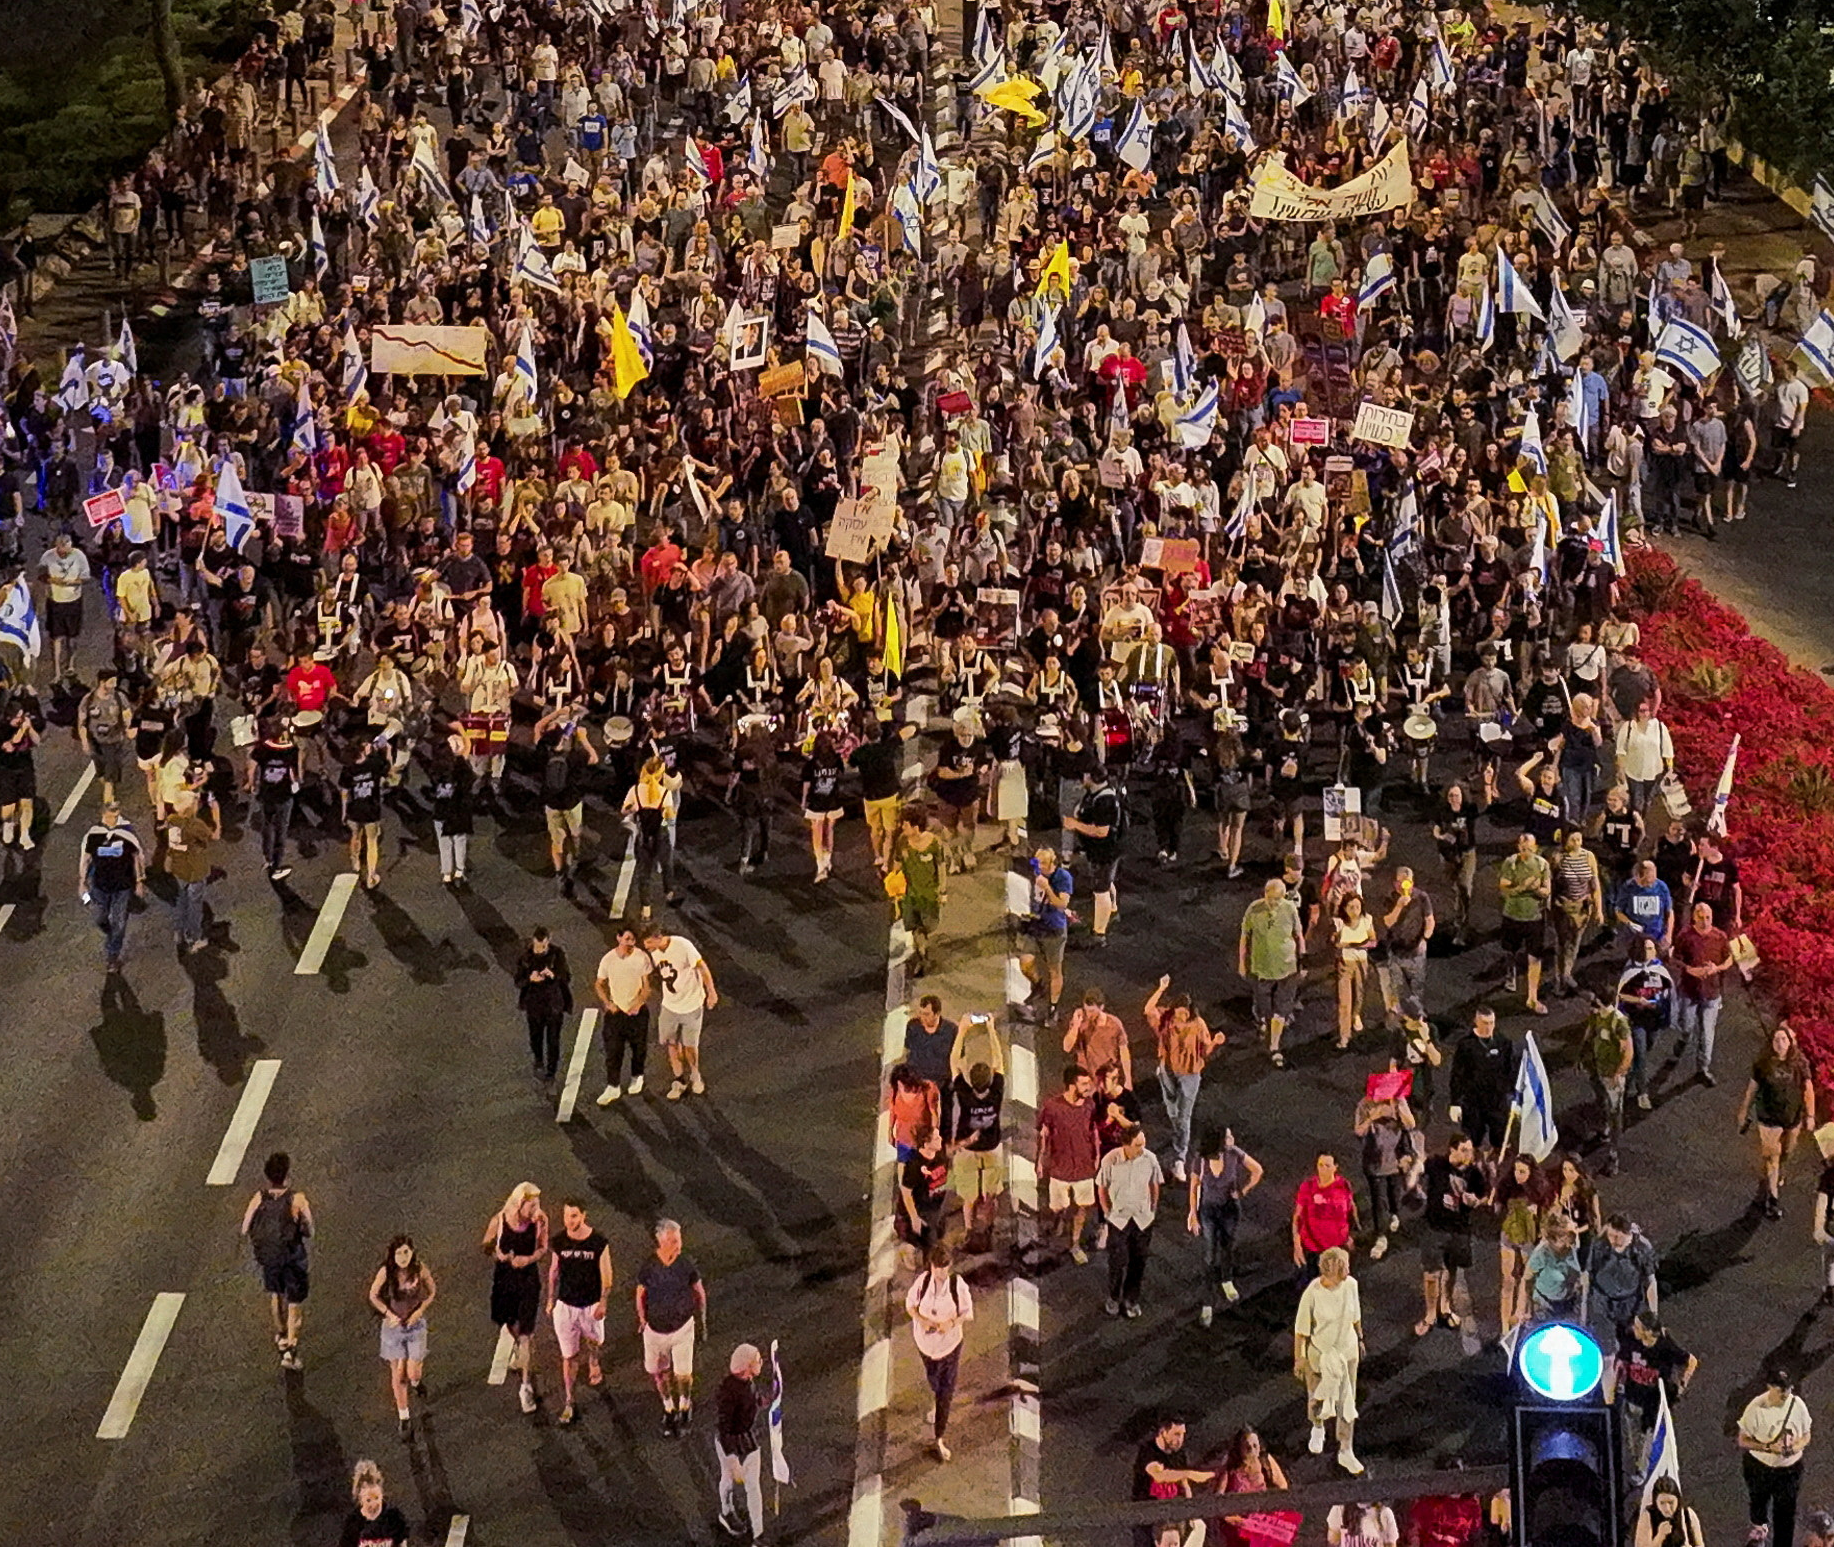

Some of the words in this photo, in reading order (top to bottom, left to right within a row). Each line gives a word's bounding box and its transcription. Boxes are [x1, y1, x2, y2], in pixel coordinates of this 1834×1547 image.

[1365, 406, 1408, 428] בחירות
[853, 503, 872, 517] אין
[838, 517, 868, 532] עסקה
